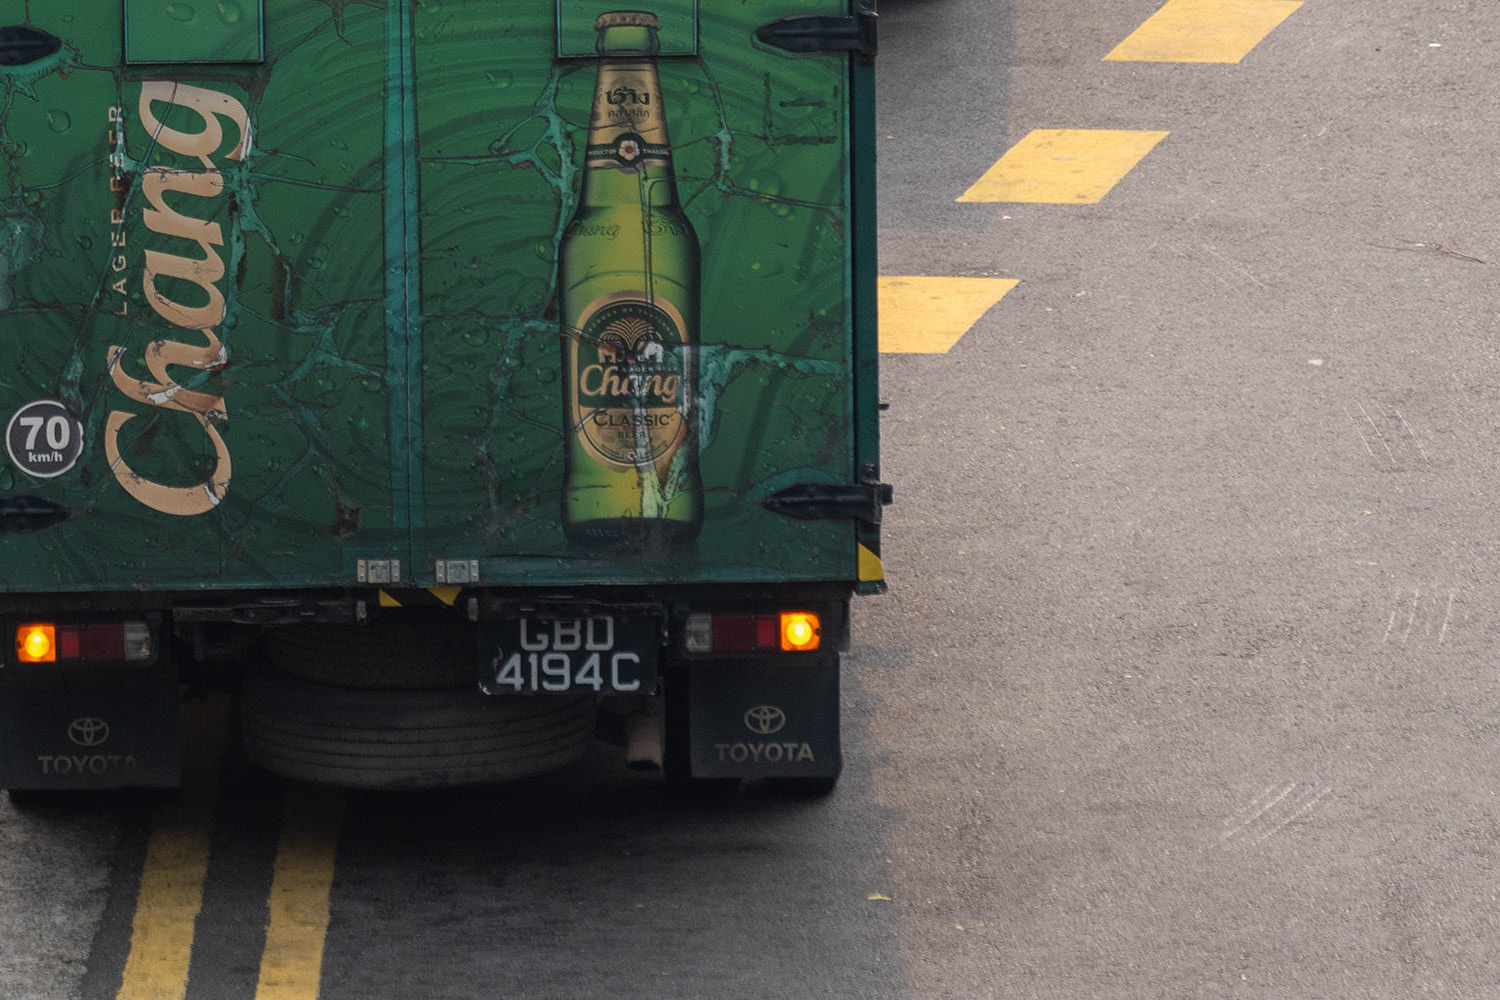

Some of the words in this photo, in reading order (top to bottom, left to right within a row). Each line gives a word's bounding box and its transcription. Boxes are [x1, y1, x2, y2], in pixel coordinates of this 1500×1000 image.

[108, 206, 129, 317] LAGER
[104, 80, 253, 516] Chang
[19, 415, 71, 451] 70
[617, 431, 647, 439] BEER
[27, 450, 64, 464] km/h
[519, 615, 615, 652] GBD
[495, 652, 642, 692] 4194C
[37, 754, 140, 776] TOYOTA
[714, 741, 817, 765] TOYOTA
